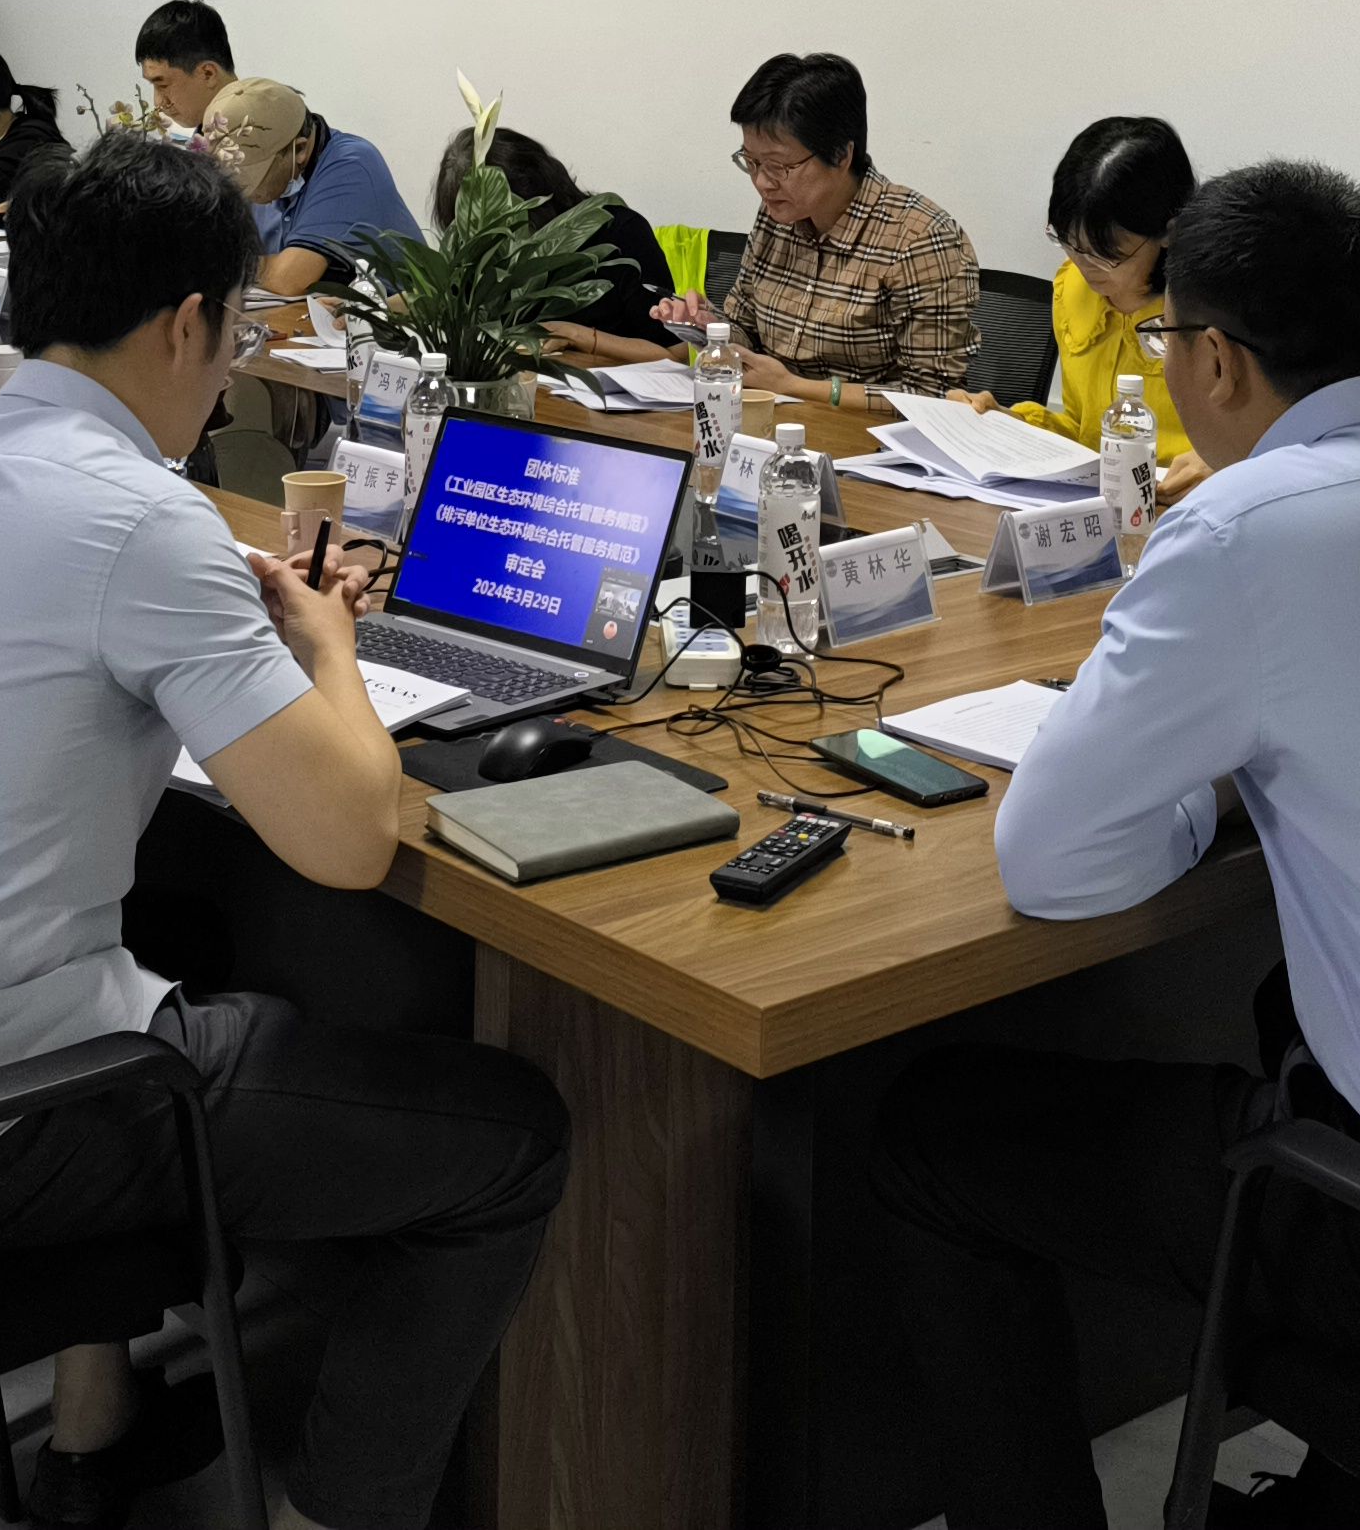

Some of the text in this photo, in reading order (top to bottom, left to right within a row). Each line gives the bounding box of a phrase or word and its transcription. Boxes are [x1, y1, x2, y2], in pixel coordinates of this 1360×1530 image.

[695, 401, 722, 459] 喝开水
[524, 458, 582, 486] 团体标准
[739, 456, 755, 479] 林
[444, 474, 650, 534] 《工业园区生态环境综合托管服务规范》
[435, 504, 641, 565] 《排污单位生态环境综合托管服务规范》
[1035, 514, 1103, 548] 谢宏昭
[504, 552, 547, 581] 审定会
[777, 522, 815, 594] 喝开水
[841, 548, 912, 588] 黄林华
[472, 577, 562, 616] 2024年3月29日
